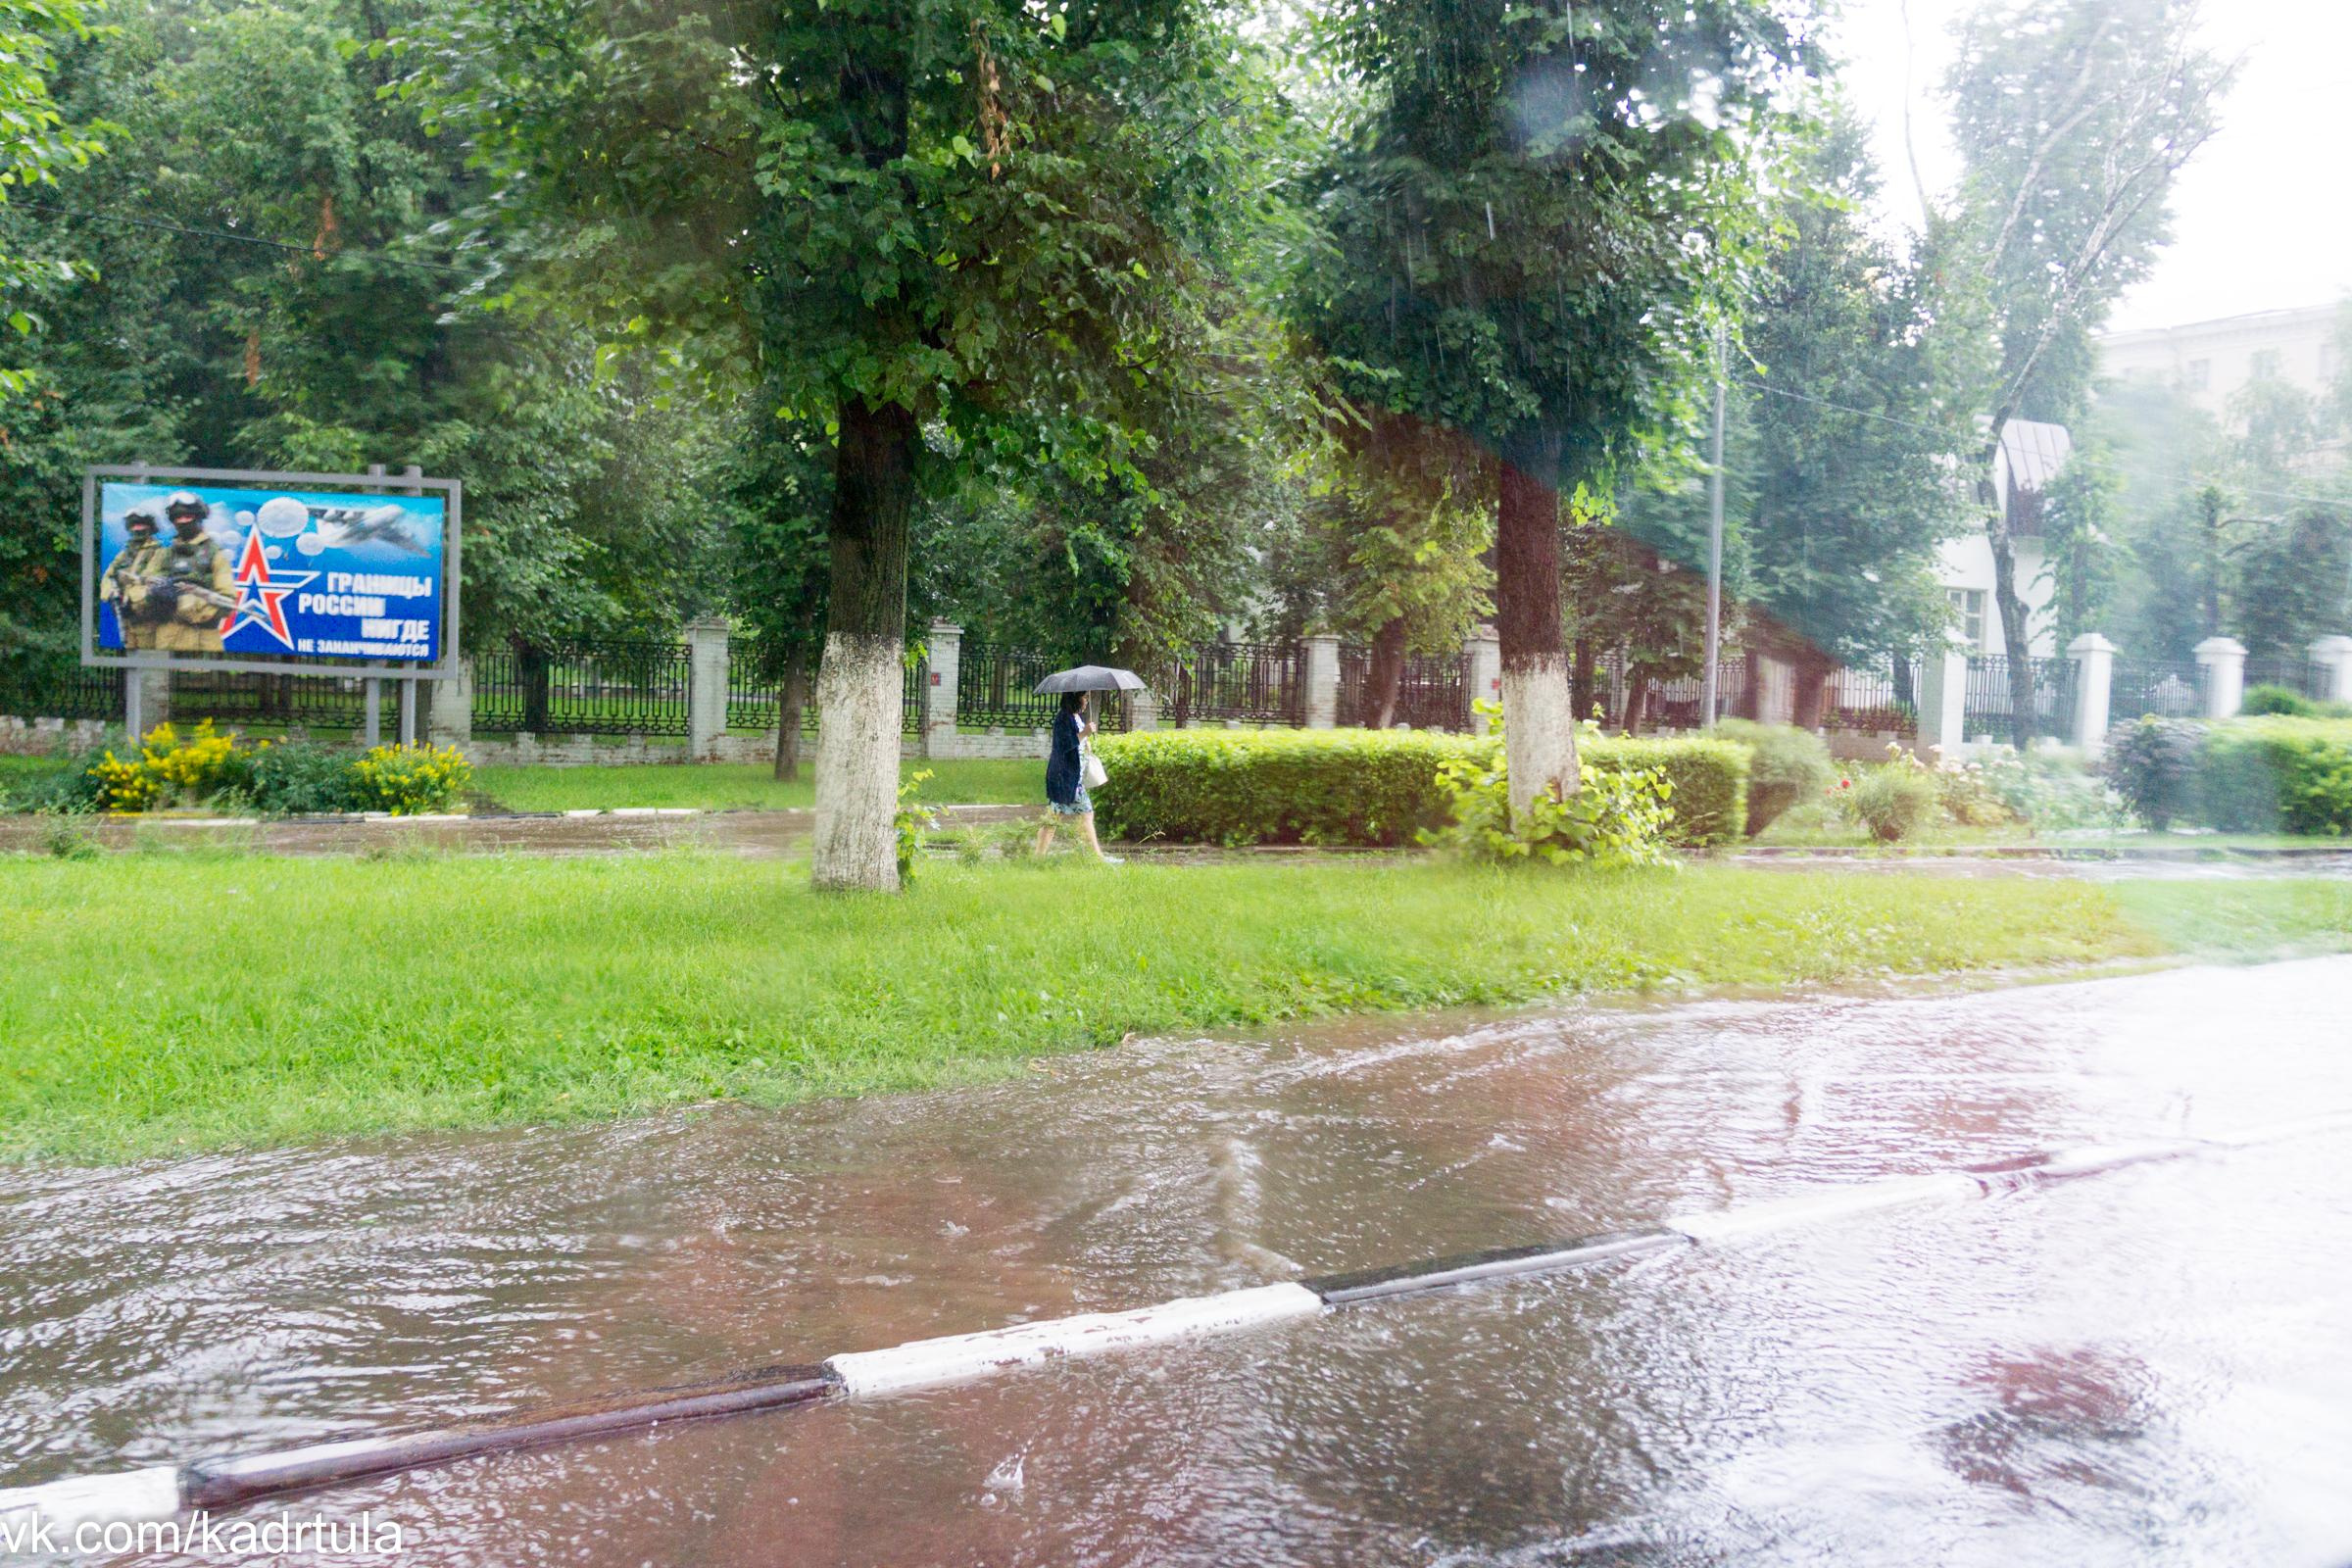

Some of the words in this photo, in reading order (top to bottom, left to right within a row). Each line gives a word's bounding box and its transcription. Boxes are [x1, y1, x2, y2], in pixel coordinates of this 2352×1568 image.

[327, 571, 432, 599] ГРАНИЦЫ
[298, 593, 386, 616] РОССИИ
[361, 617, 430, 643] НИГДЕ
[297, 638, 315, 653] НЕ
